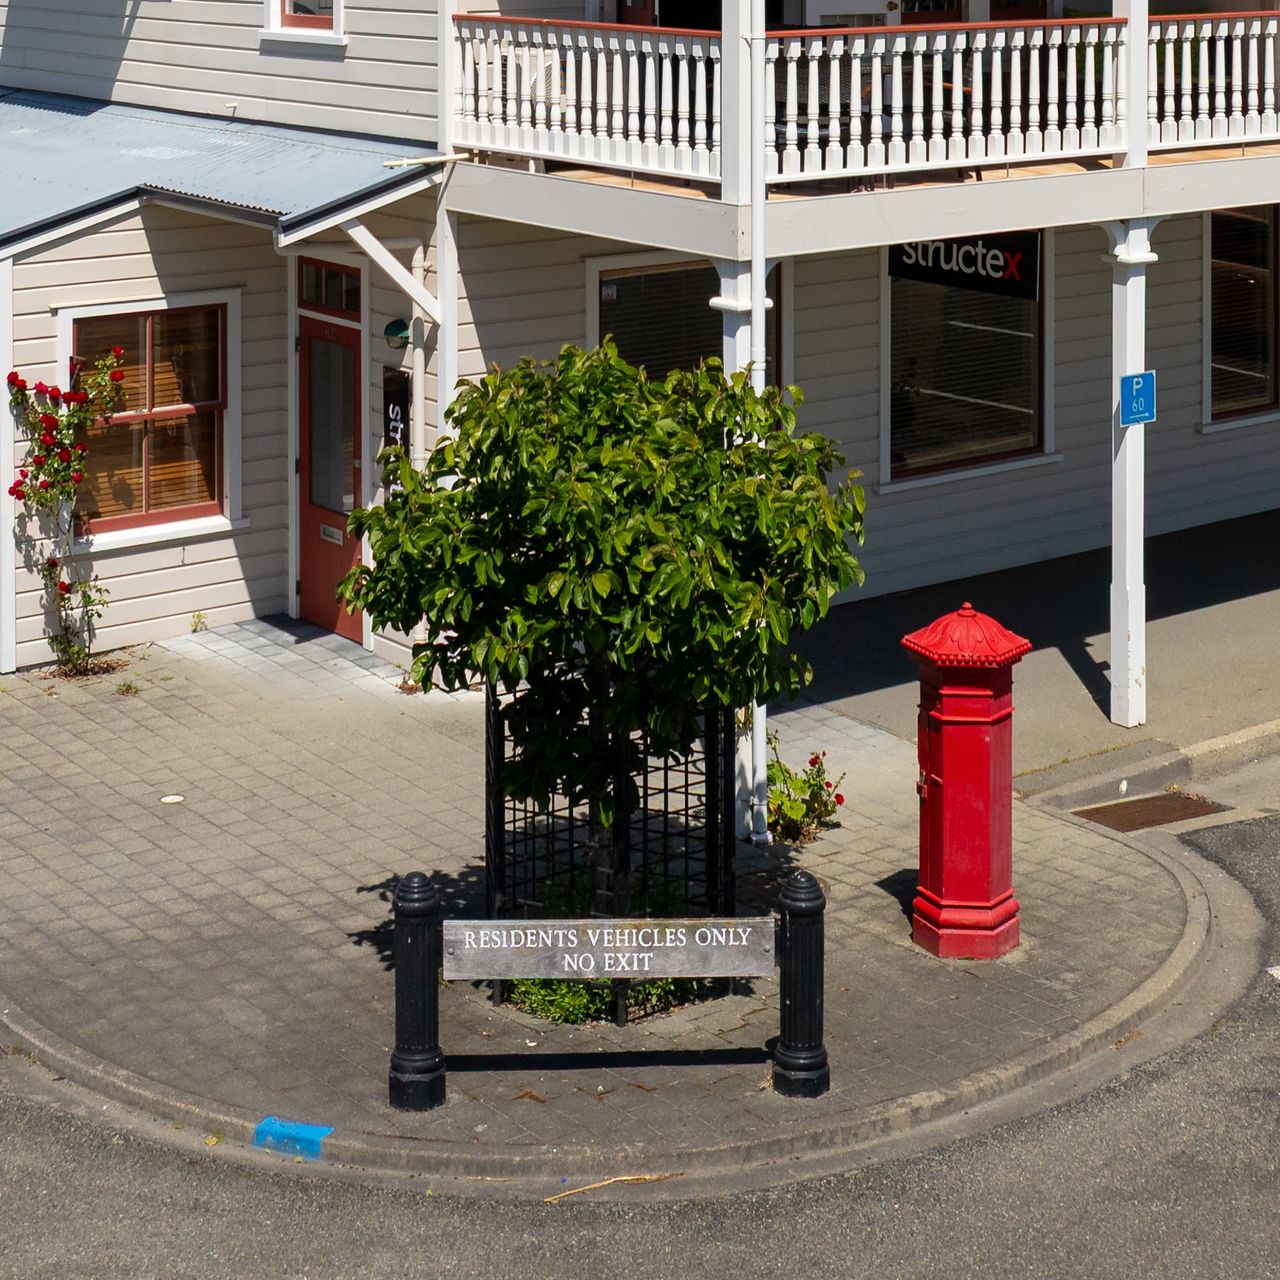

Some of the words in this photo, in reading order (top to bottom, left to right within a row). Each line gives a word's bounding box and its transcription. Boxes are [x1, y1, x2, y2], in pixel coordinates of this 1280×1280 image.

[902, 240, 1023, 281] structex
[1133, 377, 1144, 396] P
[1132, 397, 1145, 412] 60
[464, 928, 578, 949] RESIDENTS
[587, 927, 687, 948] VEHICLES
[695, 926, 752, 946] ONLY
[563, 952, 595, 972] NO
[604, 952, 654, 971] EXIT
